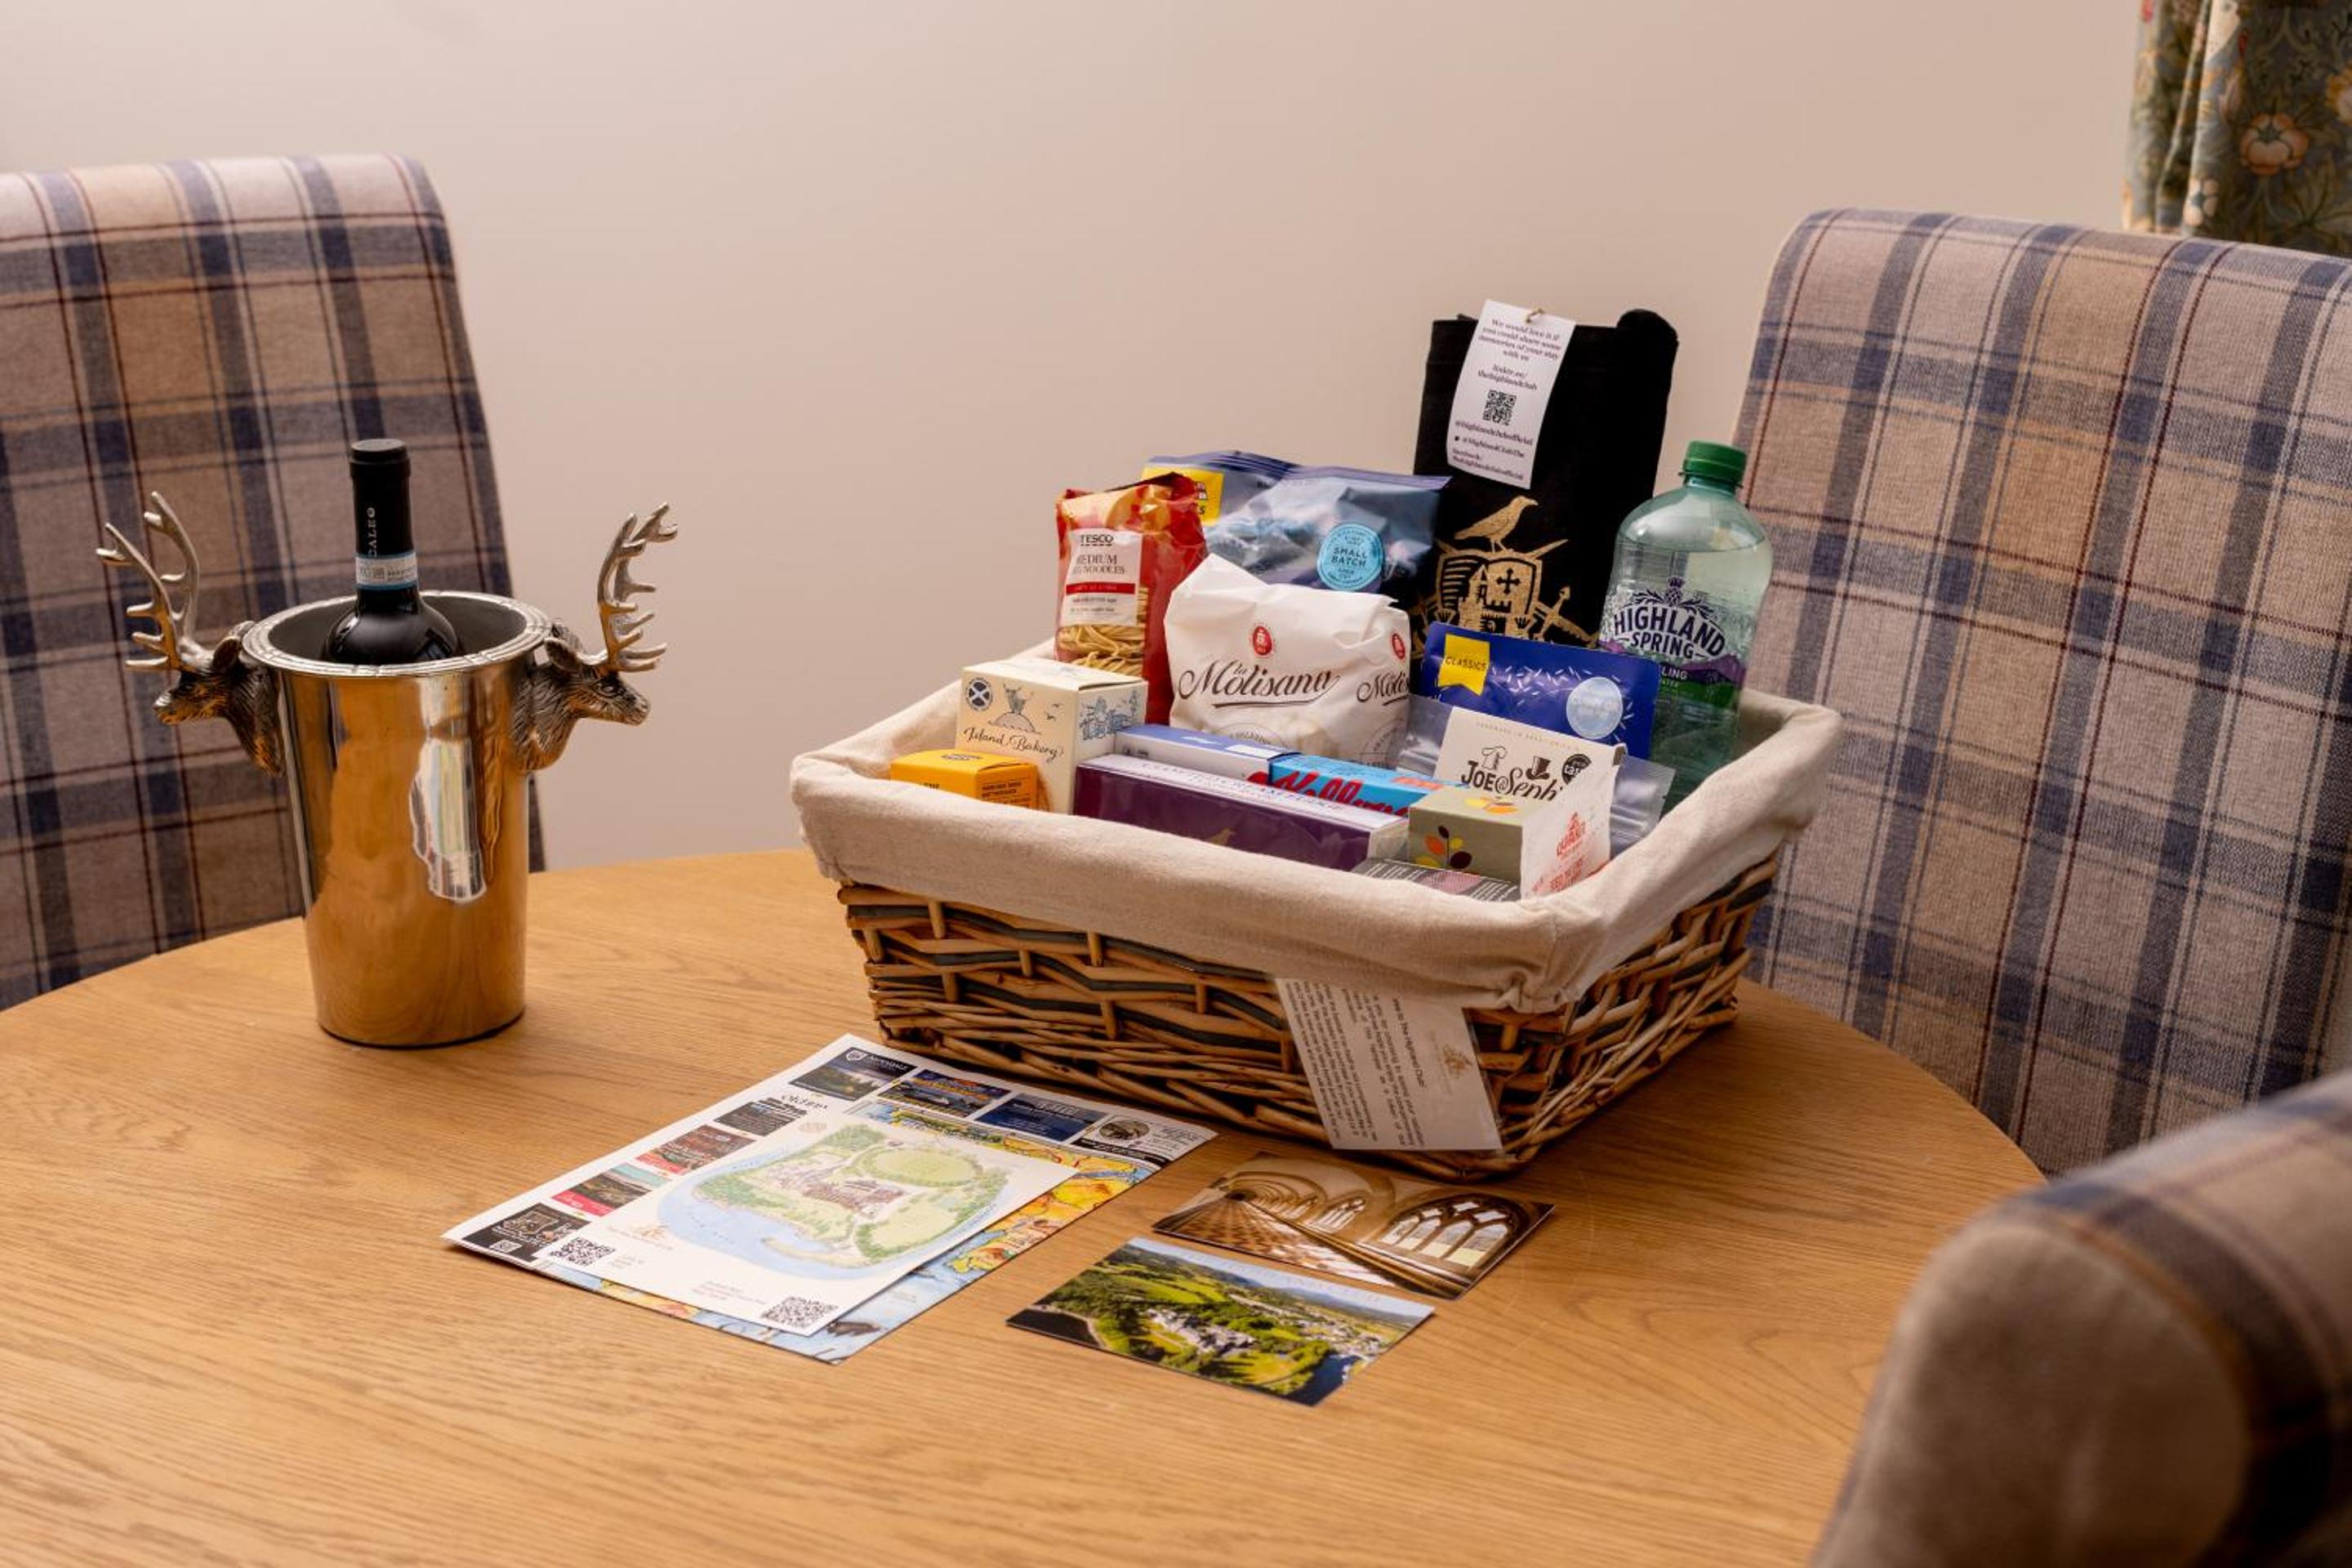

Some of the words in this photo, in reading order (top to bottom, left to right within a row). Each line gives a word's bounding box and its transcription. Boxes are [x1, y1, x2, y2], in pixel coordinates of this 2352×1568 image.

[1080, 534, 1115, 544] TESCO
[1330, 555, 1367, 568] BATCH
[1333, 546, 1368, 559] SMALL
[1084, 565, 1125, 575] NOODLES
[1614, 605, 1726, 657] HIGHLAND
[1630, 630, 1695, 660] SPRING
[1445, 656, 1488, 671] CLASSICS
[1178, 658, 1341, 701] Molisana
[964, 726, 1009, 746] Island
[1009, 734, 1059, 764] Bakery
[1461, 760, 1494, 792] JOE
